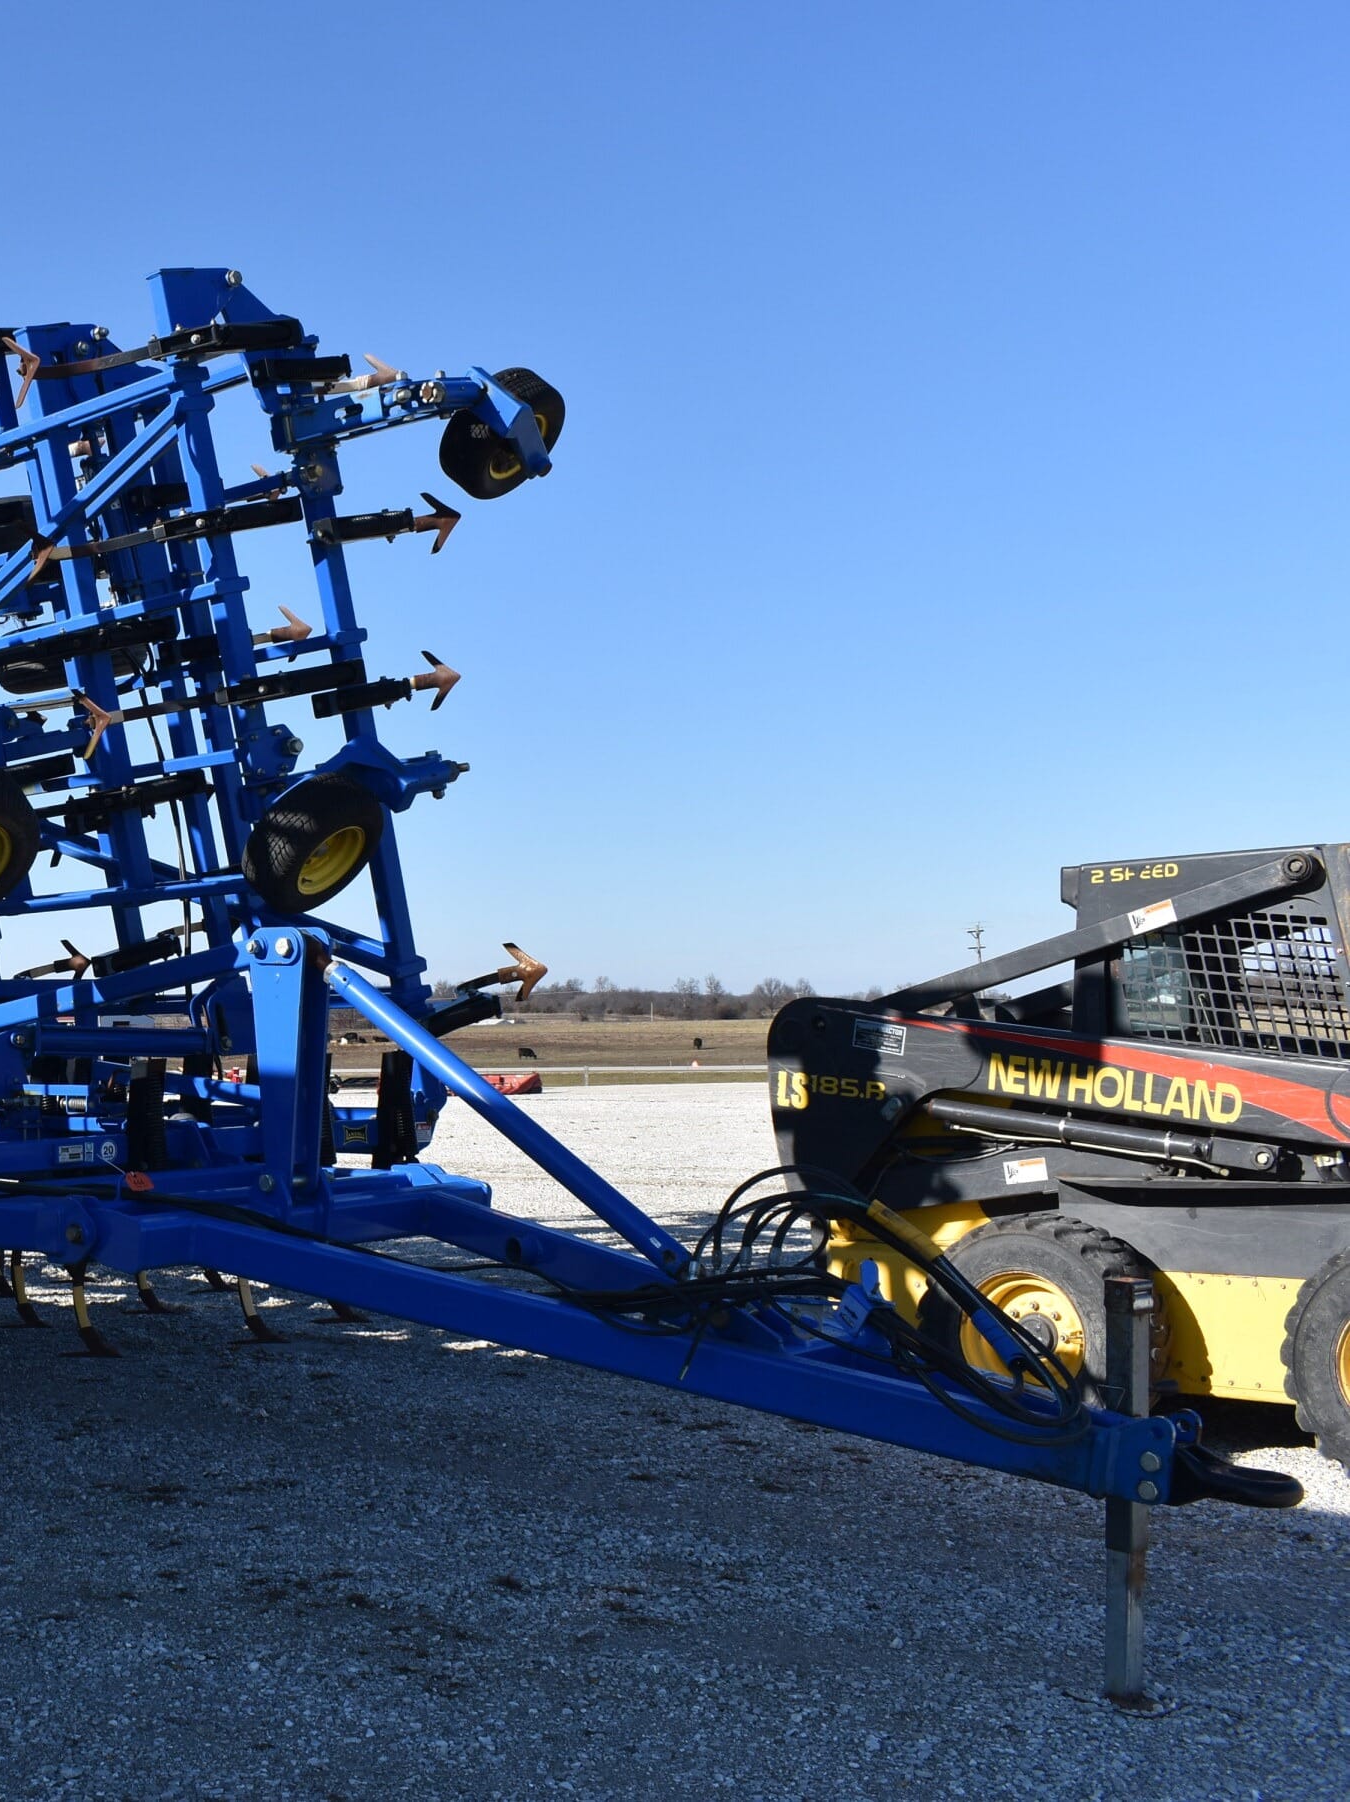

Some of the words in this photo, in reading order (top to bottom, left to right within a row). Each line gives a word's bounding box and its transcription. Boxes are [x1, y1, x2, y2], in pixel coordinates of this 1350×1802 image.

[1090, 869, 1105, 884] 2
[987, 1053, 1064, 1100] NEW
[1068, 1062, 1243, 1125] HOLLAND
[103, 1145, 114, 1156] 20
